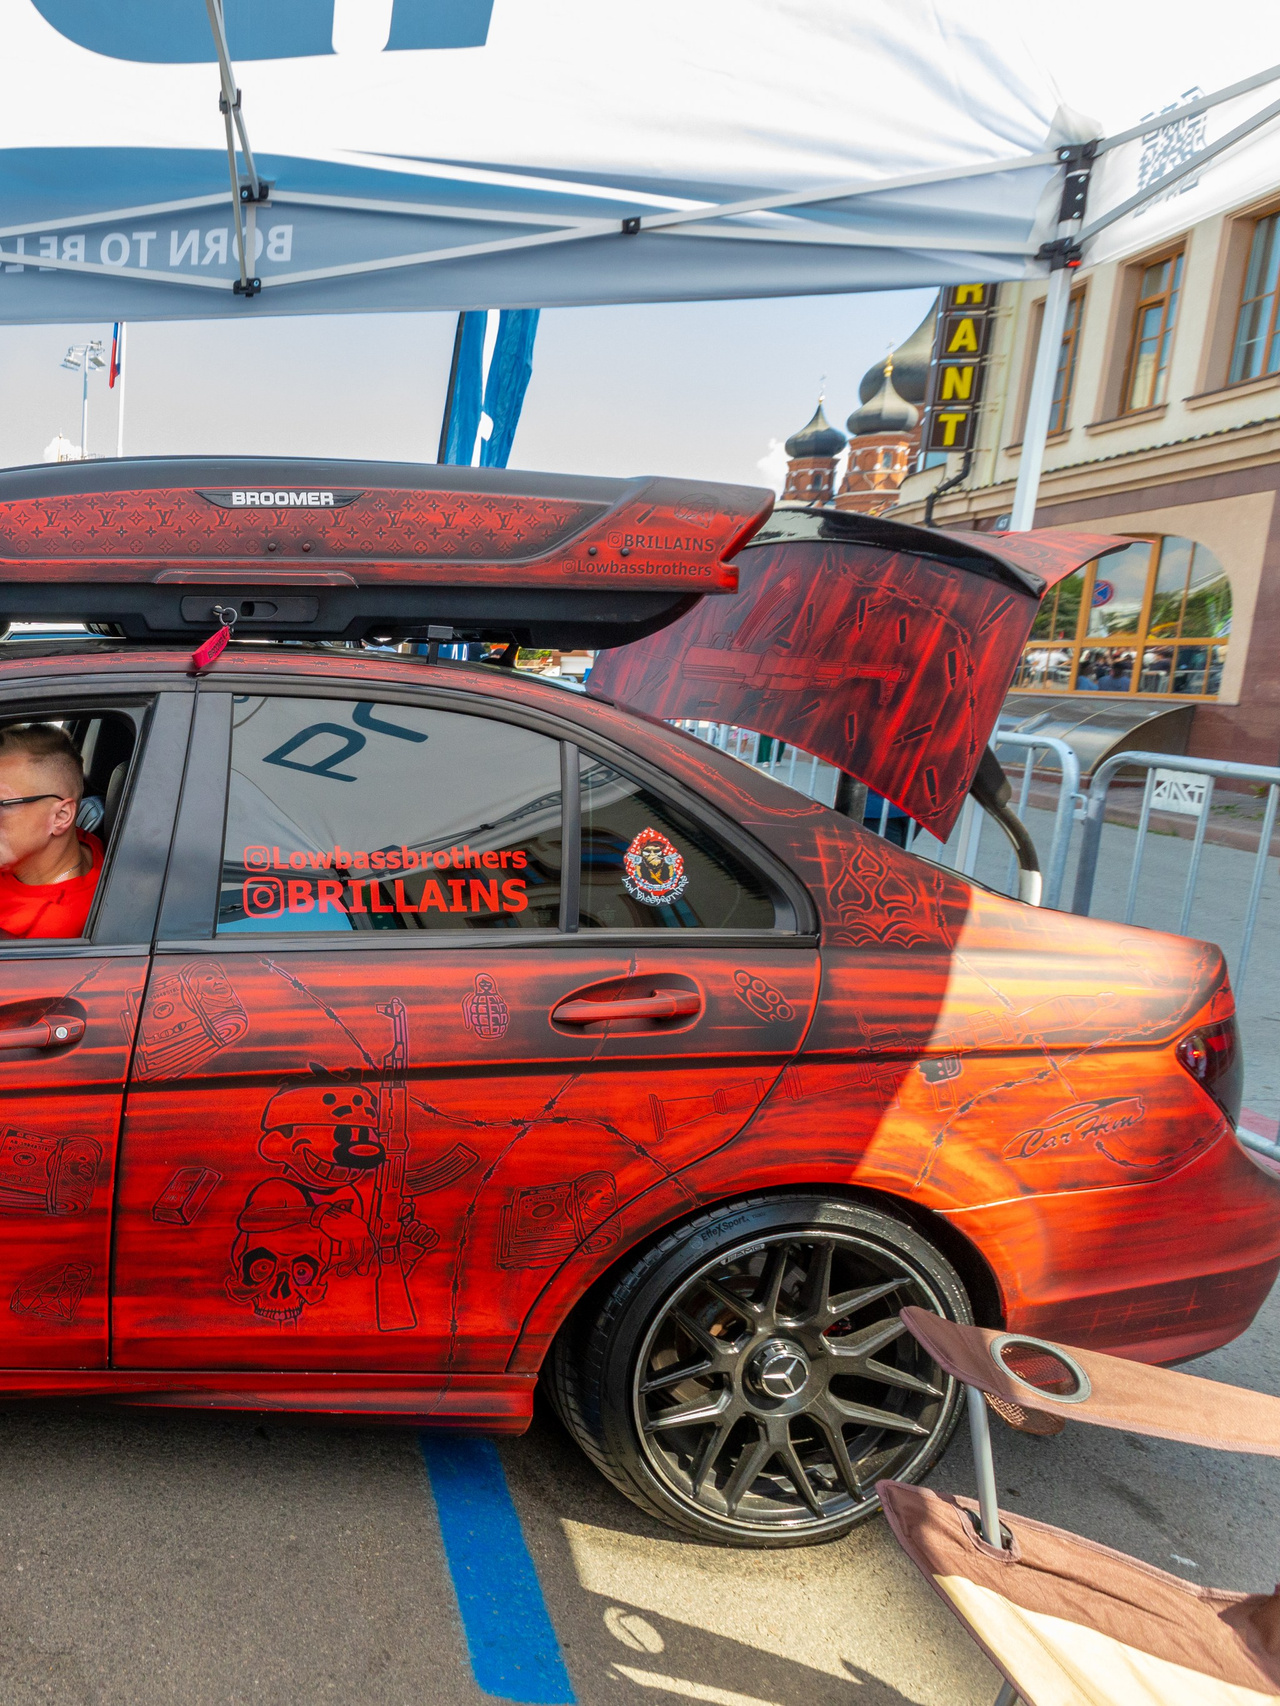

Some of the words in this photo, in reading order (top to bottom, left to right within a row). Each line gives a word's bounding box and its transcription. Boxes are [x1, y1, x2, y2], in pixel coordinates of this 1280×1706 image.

[232, 492, 334, 506] BROOMER
[624, 534, 714, 552] BRILLAINS
[577, 560, 712, 577] Lowbassbrothers
[273, 844, 528, 870] Lowbassbrothers
[287, 878, 529, 914] BRILLAINS
